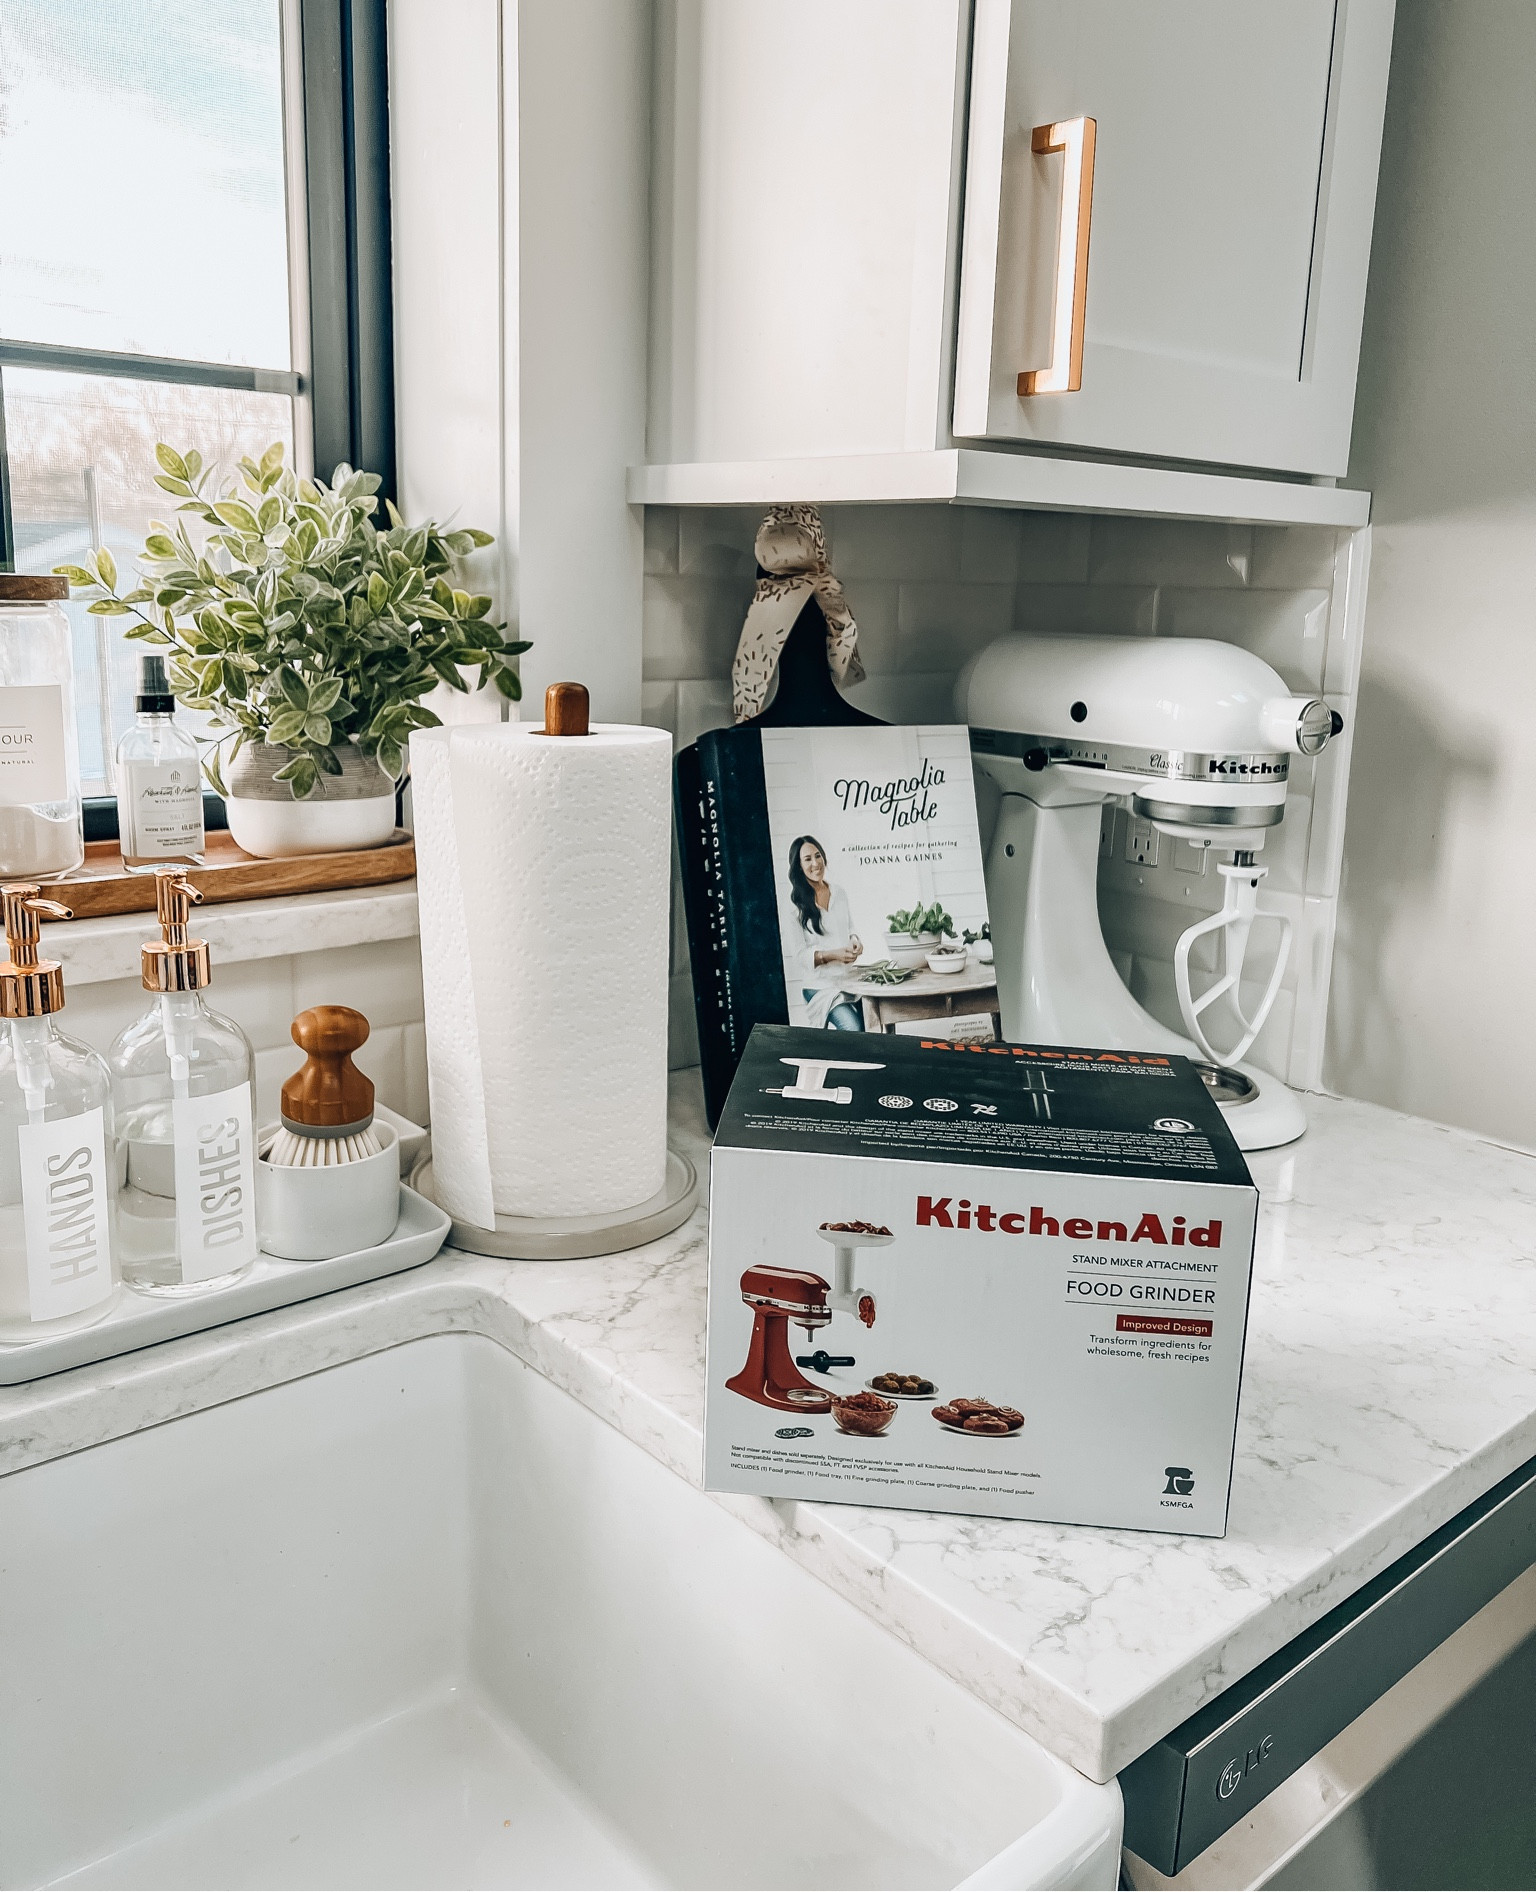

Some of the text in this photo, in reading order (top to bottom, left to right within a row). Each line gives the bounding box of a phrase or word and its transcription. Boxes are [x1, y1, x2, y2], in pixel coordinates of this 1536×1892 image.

[1101, 753, 1108, 761] 10
[834, 757, 945, 814] Magnolia
[891, 789, 938, 831] Table
[707, 780, 722, 881] MAGNOLIA
[848, 844, 881, 852] collection
[891, 842, 915, 850] recipes
[916, 841, 926, 850] for
[927, 840, 958, 849] gathering
[860, 852, 943, 866] JOANNA GAINES
[717, 890, 728, 948] TABLE
[920, 1041, 1171, 1066] KitchenAid
[196, 1117, 244, 1249] DISHES
[47, 1146, 98, 1286] HANDS
[915, 1195, 1223, 1249] KitchenAid
[1072, 1254, 1219, 1273] STAND MIXER ATTACHMENT
[1066, 1280, 1216, 1304] FOOD GRINDER
[1122, 1319, 1208, 1334] Improved Design
[1090, 1334, 1213, 1351] Transform ingredients for
[1087, 1346, 1210, 1364] wholesome, fresh recipes
[730, 1463, 759, 1471] INCLUDES
[827, 1455, 853, 1463] Designed
[854, 1457, 882, 1466] exclusively
[1160, 1500, 1194, 1509] KSMFGA
